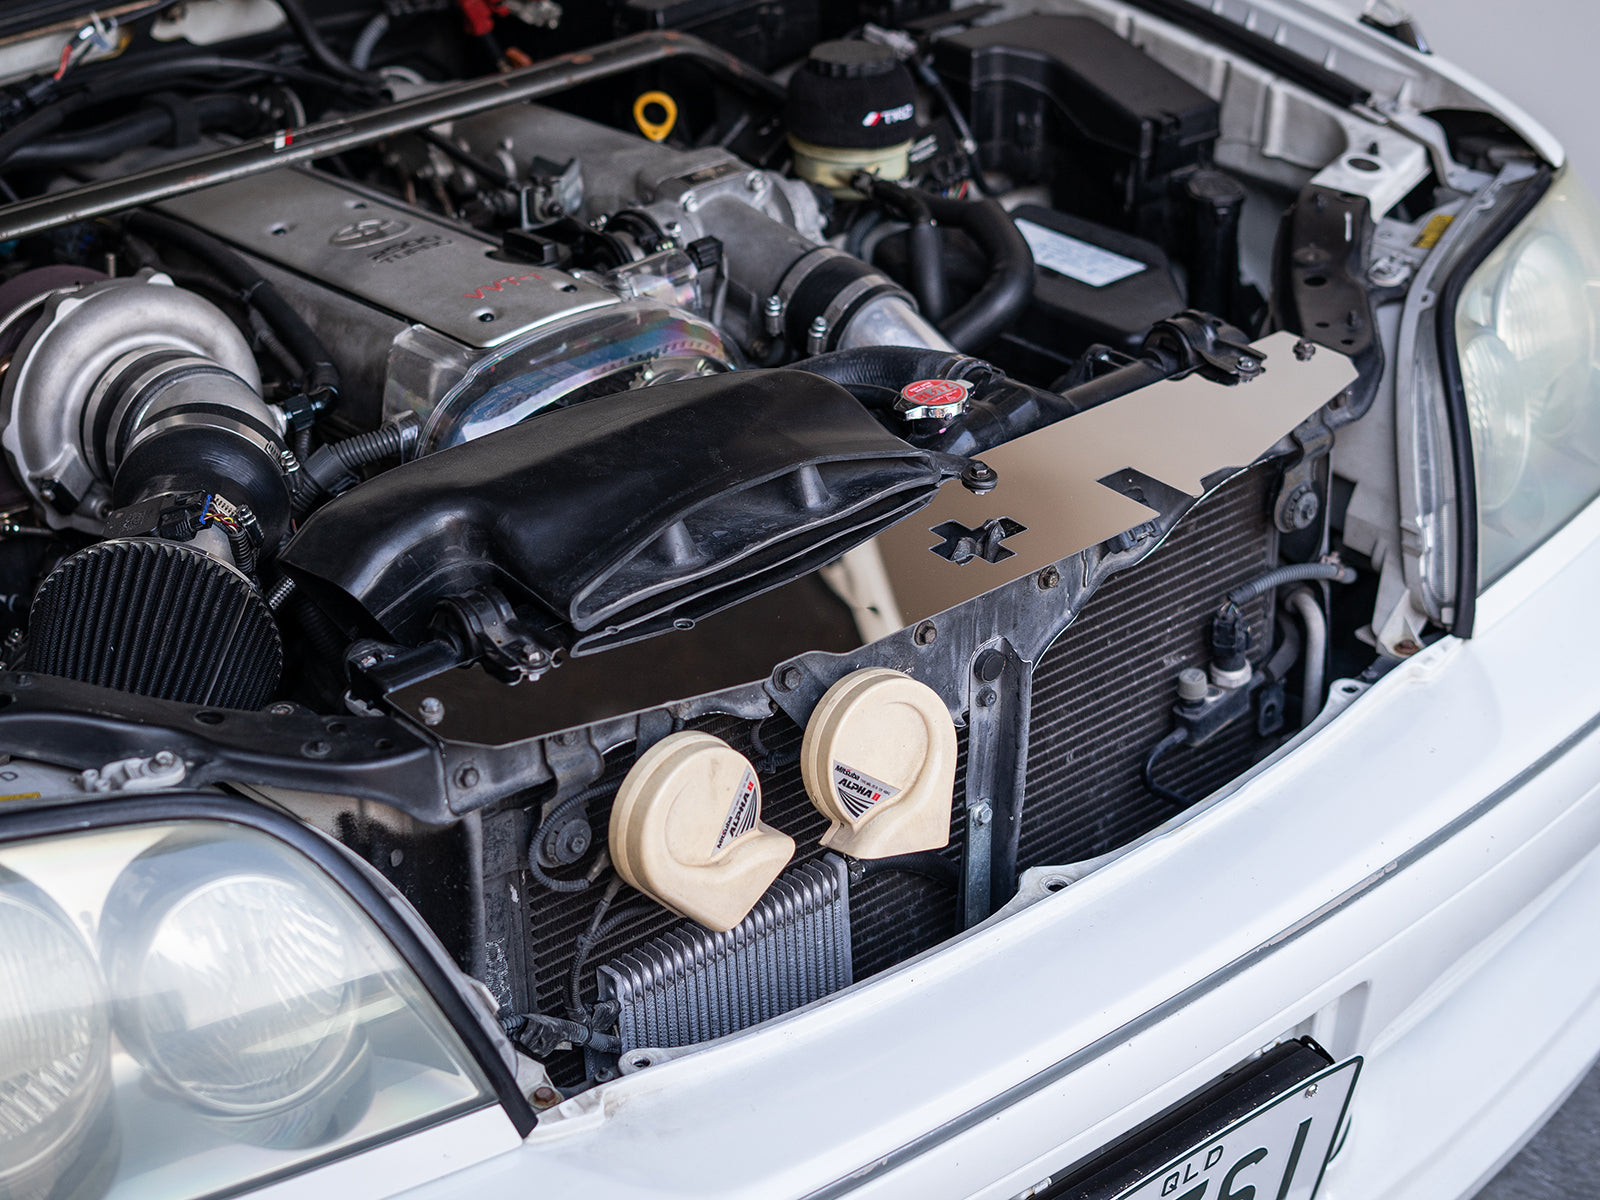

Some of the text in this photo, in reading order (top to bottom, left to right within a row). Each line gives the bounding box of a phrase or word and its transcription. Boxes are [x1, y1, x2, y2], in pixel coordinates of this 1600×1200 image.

[838, 777, 873, 799] ALPHA
[729, 792, 750, 838] ALPHA
[1160, 1144, 1225, 1197] QLD
